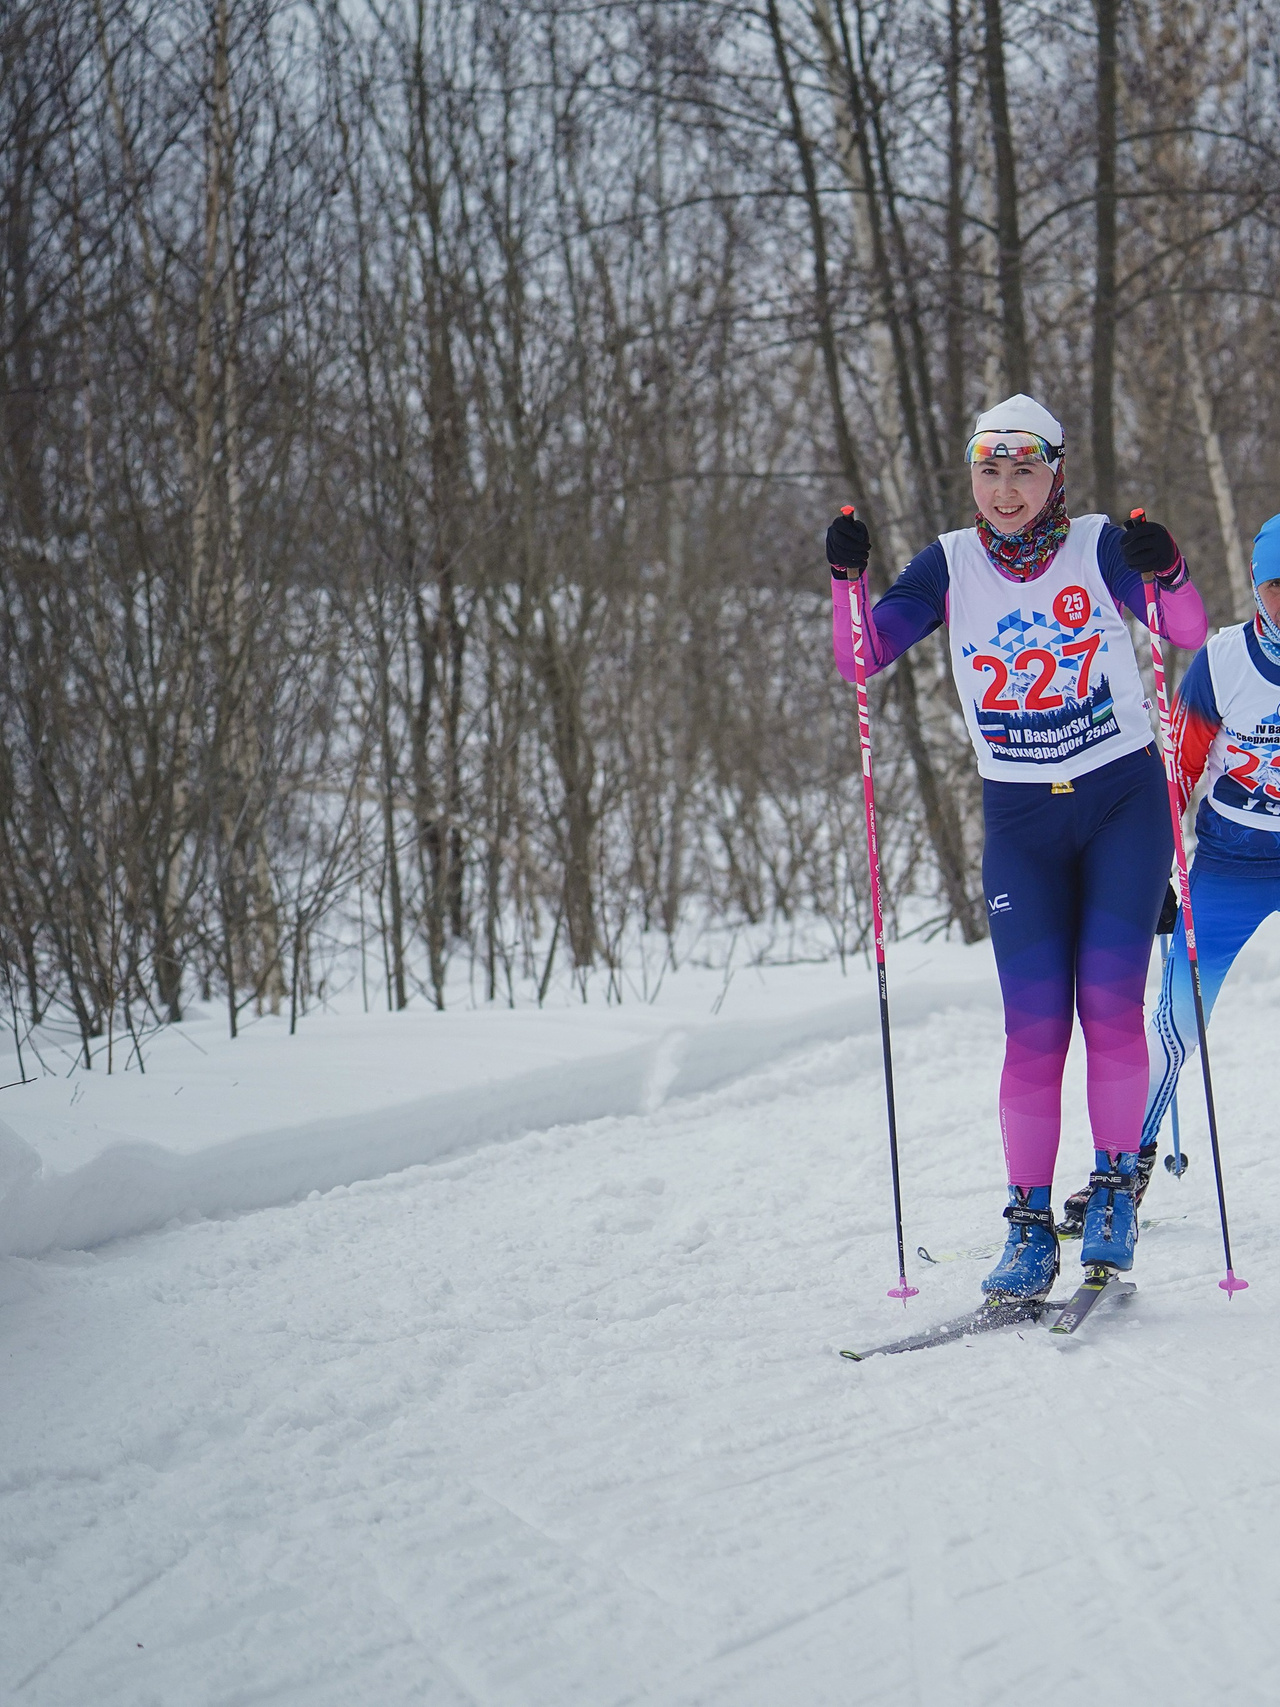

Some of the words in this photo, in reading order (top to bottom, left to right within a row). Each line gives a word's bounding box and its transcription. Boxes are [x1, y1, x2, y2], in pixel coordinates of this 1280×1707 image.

[1062, 592, 1084, 613] 25
[972, 633, 1101, 711] 227
[1008, 728, 1022, 743] IV
[1023, 715, 1090, 744] BashkirSki
[1255, 724, 1267, 734] IV
[1089, 1174, 1122, 1183] SPINE
[1012, 1209, 1050, 1221] SPINE
